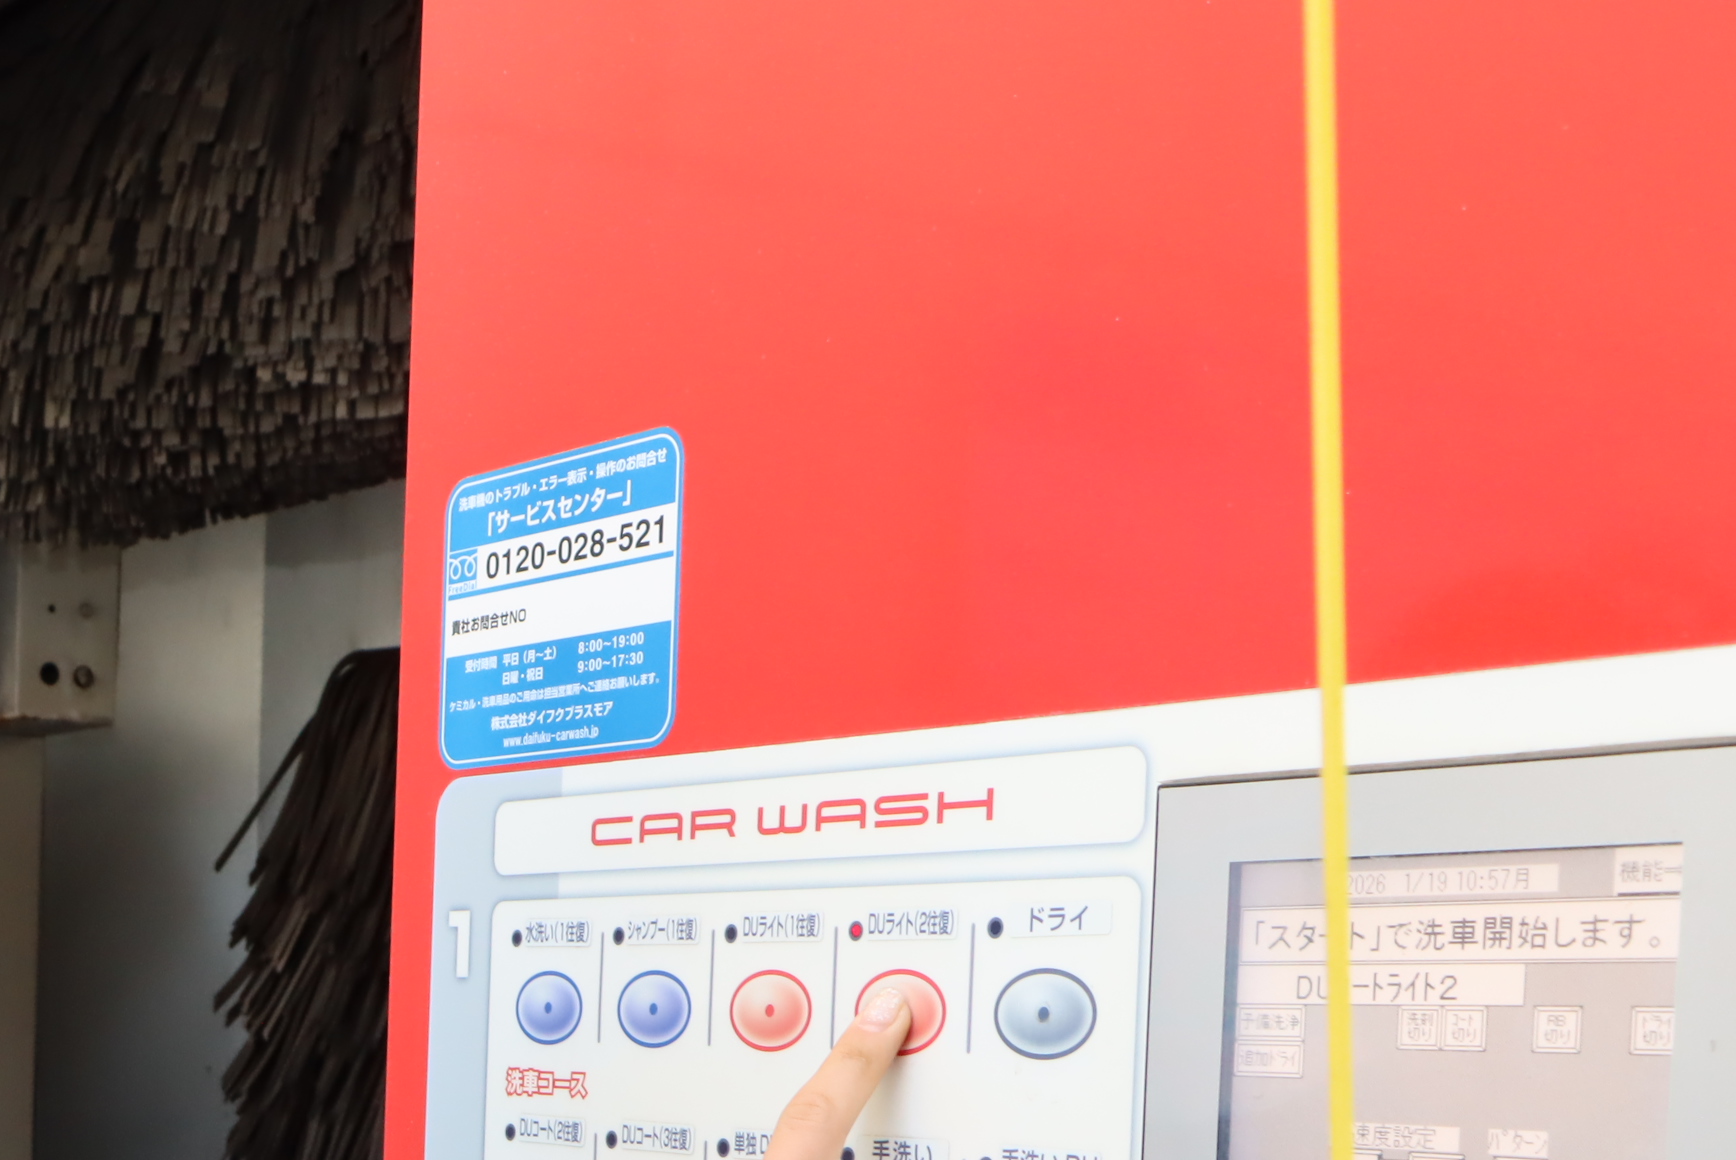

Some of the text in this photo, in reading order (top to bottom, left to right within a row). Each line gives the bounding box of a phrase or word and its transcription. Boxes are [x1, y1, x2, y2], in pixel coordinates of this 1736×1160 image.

[487, 480, 632, 537] 「サービスセンター」
[486, 515, 664, 579] 0120-028-521
[452, 608, 527, 636] 貴社お問合せNO
[464, 655, 498, 673] 受付時間
[502, 667, 543, 685] 日曜・祝日
[491, 701, 614, 731] 株式会社ダイフクプラスモア
[503, 725, 599, 748] www.daifuku-carwash.jp
[591, 787, 995, 846] CAR WASH
[1347, 873, 1386, 895] 2026
[1405, 871, 1448, 893] 1/19
[525, 920, 590, 943] 水洗い(1往復)
[628, 917, 698, 942] シャンプー(1往復)
[742, 912, 821, 939] DUライト(1往復)
[868, 910, 954, 937] DUライト(2往復)
[1029, 906, 1089, 932] ドライ
[448, 909, 471, 979] 1
[1407, 1027, 1432, 1042] 切り
[1451, 1028, 1476, 1043] 切り
[1544, 1029, 1571, 1044] 切り
[506, 1066, 589, 1099] 洗車コース
[519, 1117, 584, 1144] DUコート(2往復)
[622, 1124, 692, 1152] DUコート(3往復)
[734, 1131, 774, 1156] 単独 D
